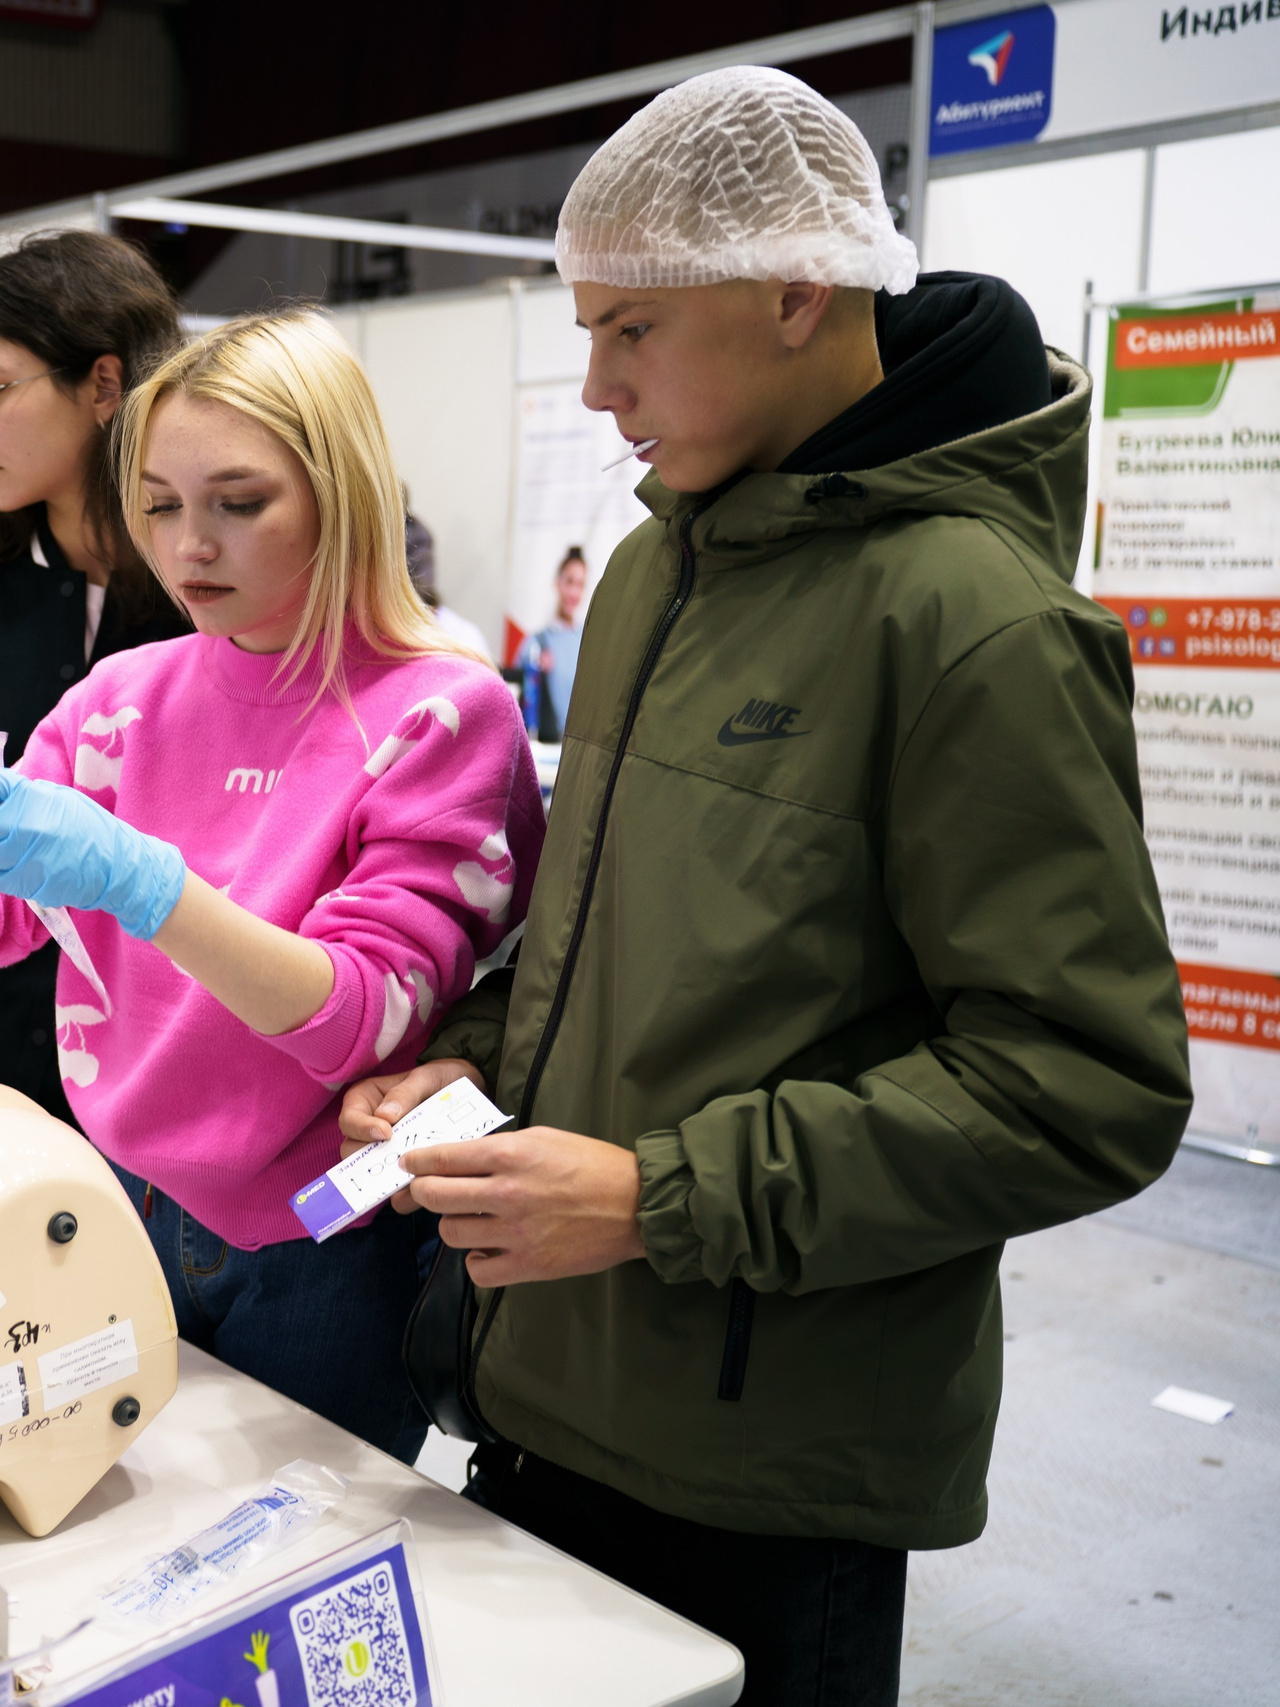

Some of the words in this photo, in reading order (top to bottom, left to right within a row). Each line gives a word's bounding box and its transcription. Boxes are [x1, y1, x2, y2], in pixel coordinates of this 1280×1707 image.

[1126, 319, 1277, 354] Семейный
[734, 698, 802, 734] NIKE
[1135, 690, 1254, 719] ОМОГАЮ
[1185, 1006, 1238, 1033] осле
